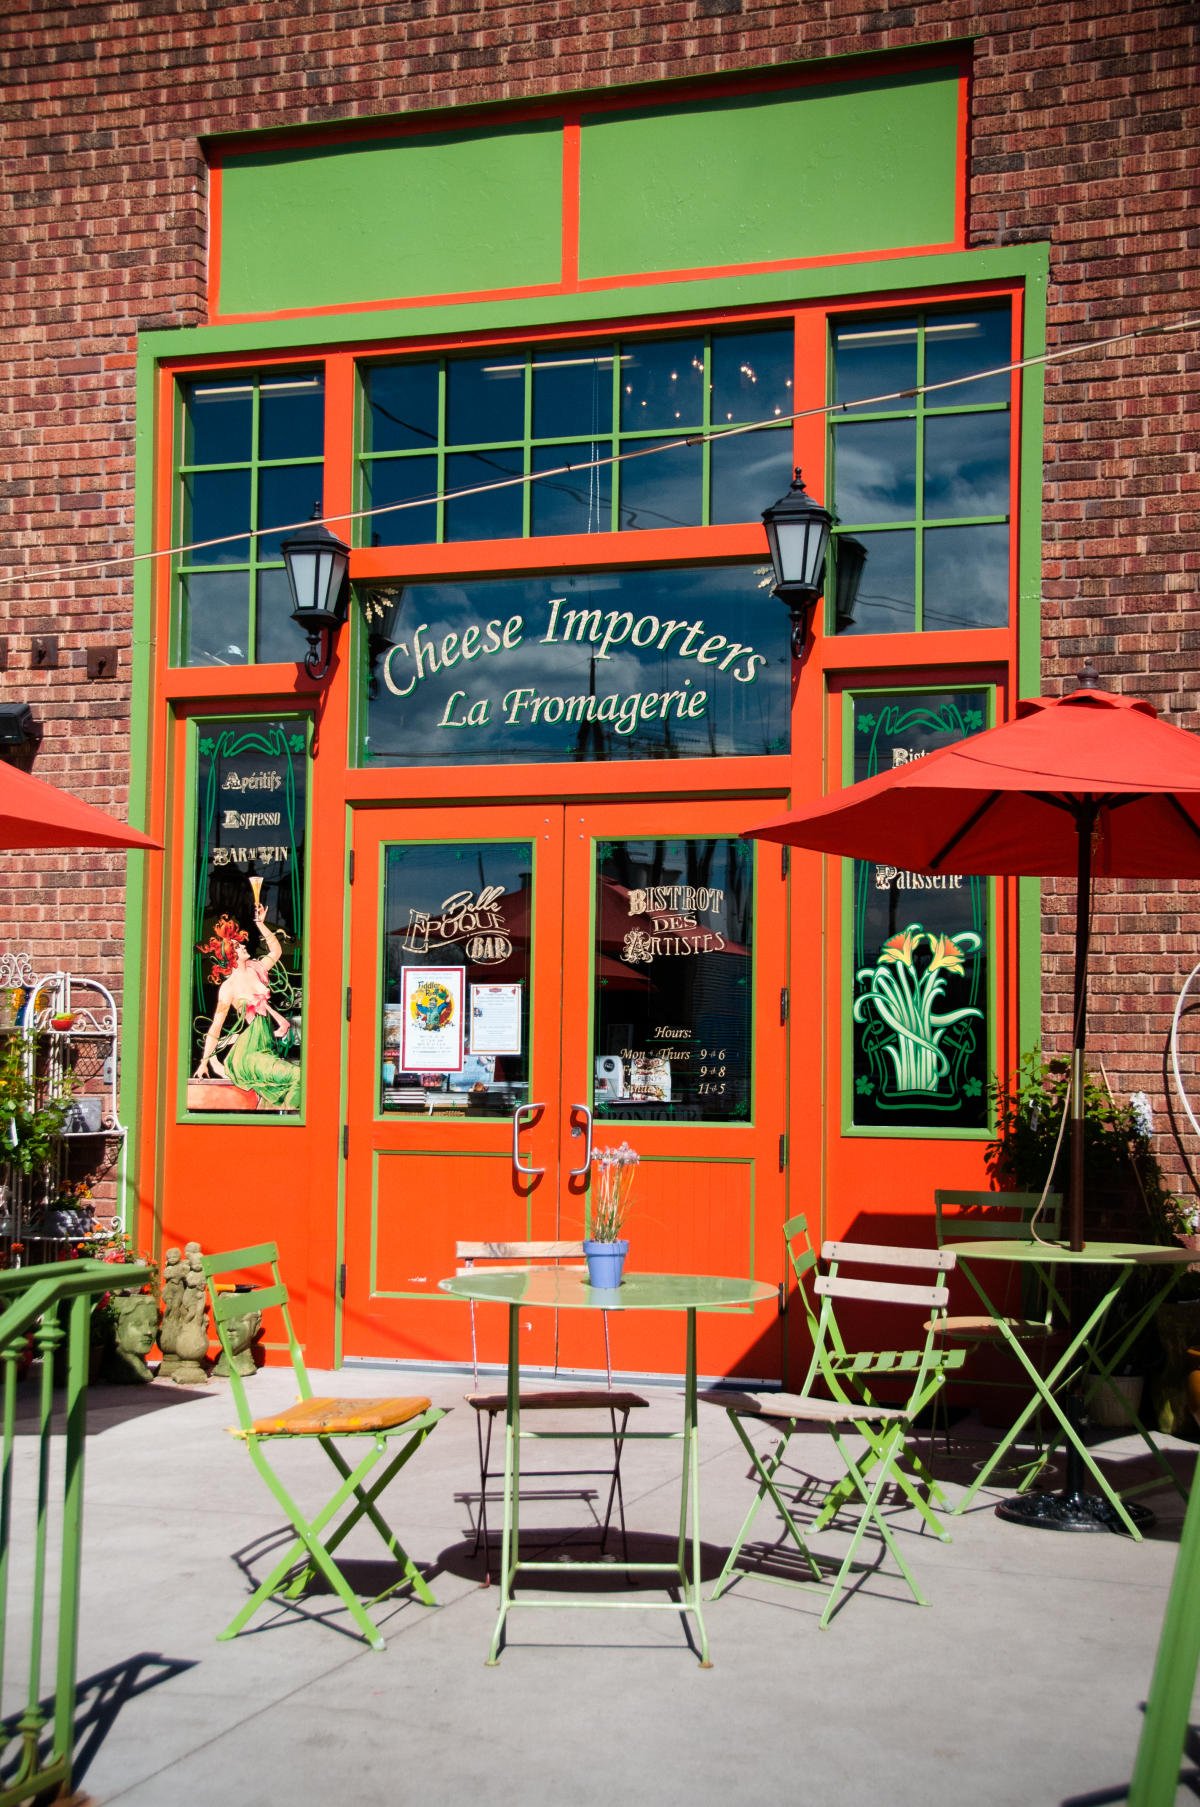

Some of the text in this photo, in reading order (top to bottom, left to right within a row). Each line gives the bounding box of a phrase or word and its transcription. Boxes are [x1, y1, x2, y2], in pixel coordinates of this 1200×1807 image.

[383, 597, 768, 698] Cheese Importers
[437, 679, 709, 736] La Fromagerie
[221, 770, 282, 794] Apéritifs
[222, 810, 281, 830] Espresso
[213, 847, 248, 866] BAR
[257, 846, 289, 865] VIN
[441, 885, 505, 920] Belle
[628, 885, 724, 916] BISTROT
[653, 914, 698, 932] DES
[471, 936, 508, 959] BAR
[620, 928, 726, 964] ARTISTES
[654, 1025, 692, 1039] Hours:
[620, 1048, 646, 1060] Mon
[656, 1047, 691, 1060] Thurs
